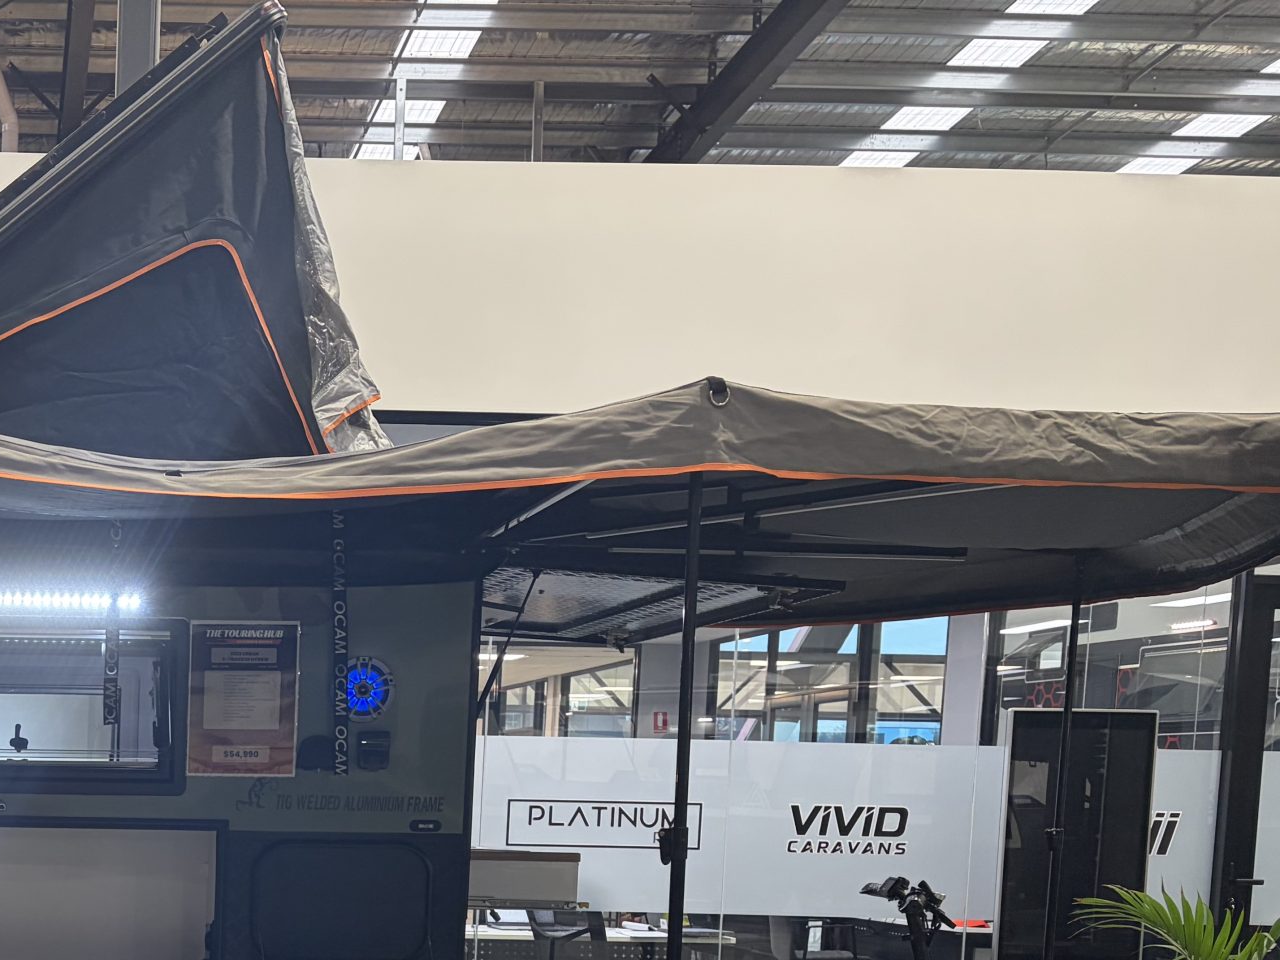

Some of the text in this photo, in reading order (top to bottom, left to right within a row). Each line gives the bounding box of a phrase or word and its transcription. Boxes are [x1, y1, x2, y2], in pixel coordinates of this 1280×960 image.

[206, 629, 284, 638] THE TOURING HUB
[334, 600, 347, 653] OCAM
[336, 663, 347, 715] OCAM
[104, 682, 117, 724] CAM
[276, 793, 444, 813] TIG WELDED ALUMINIUM FRAME
[528, 805, 676, 828] PLATINUM
[786, 840, 908, 855] CARAVANS
